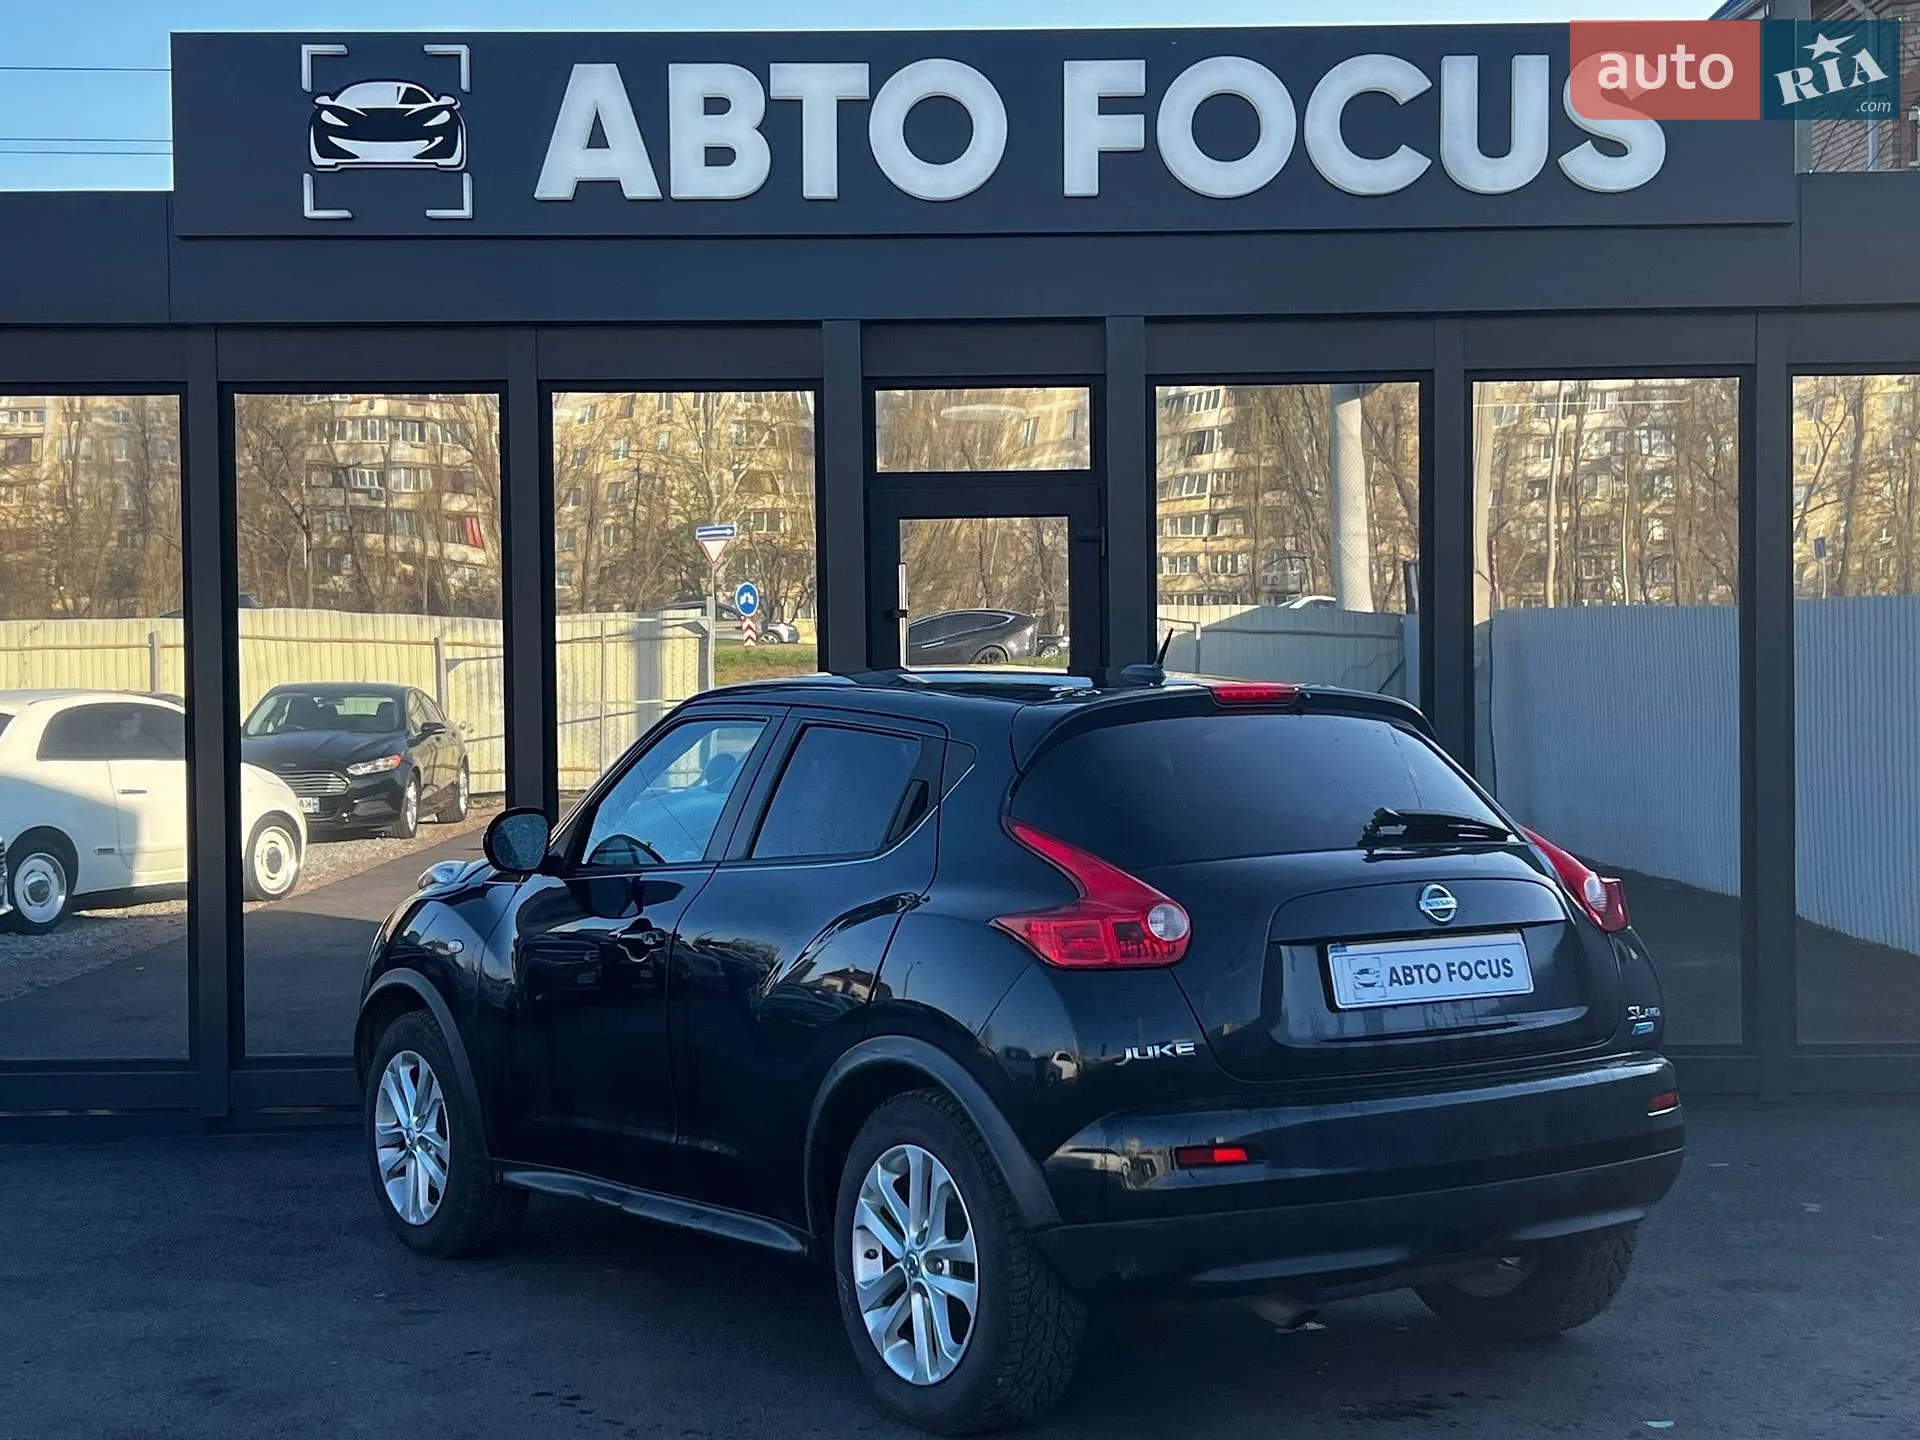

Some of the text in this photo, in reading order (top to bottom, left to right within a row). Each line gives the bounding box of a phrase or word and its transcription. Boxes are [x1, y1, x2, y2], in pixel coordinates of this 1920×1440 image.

[533, 53, 1667, 202] АВТО FOCUS
[1389, 958, 1514, 987] АВТО FOCUS
[1114, 1041, 1196, 1067] JUKE
